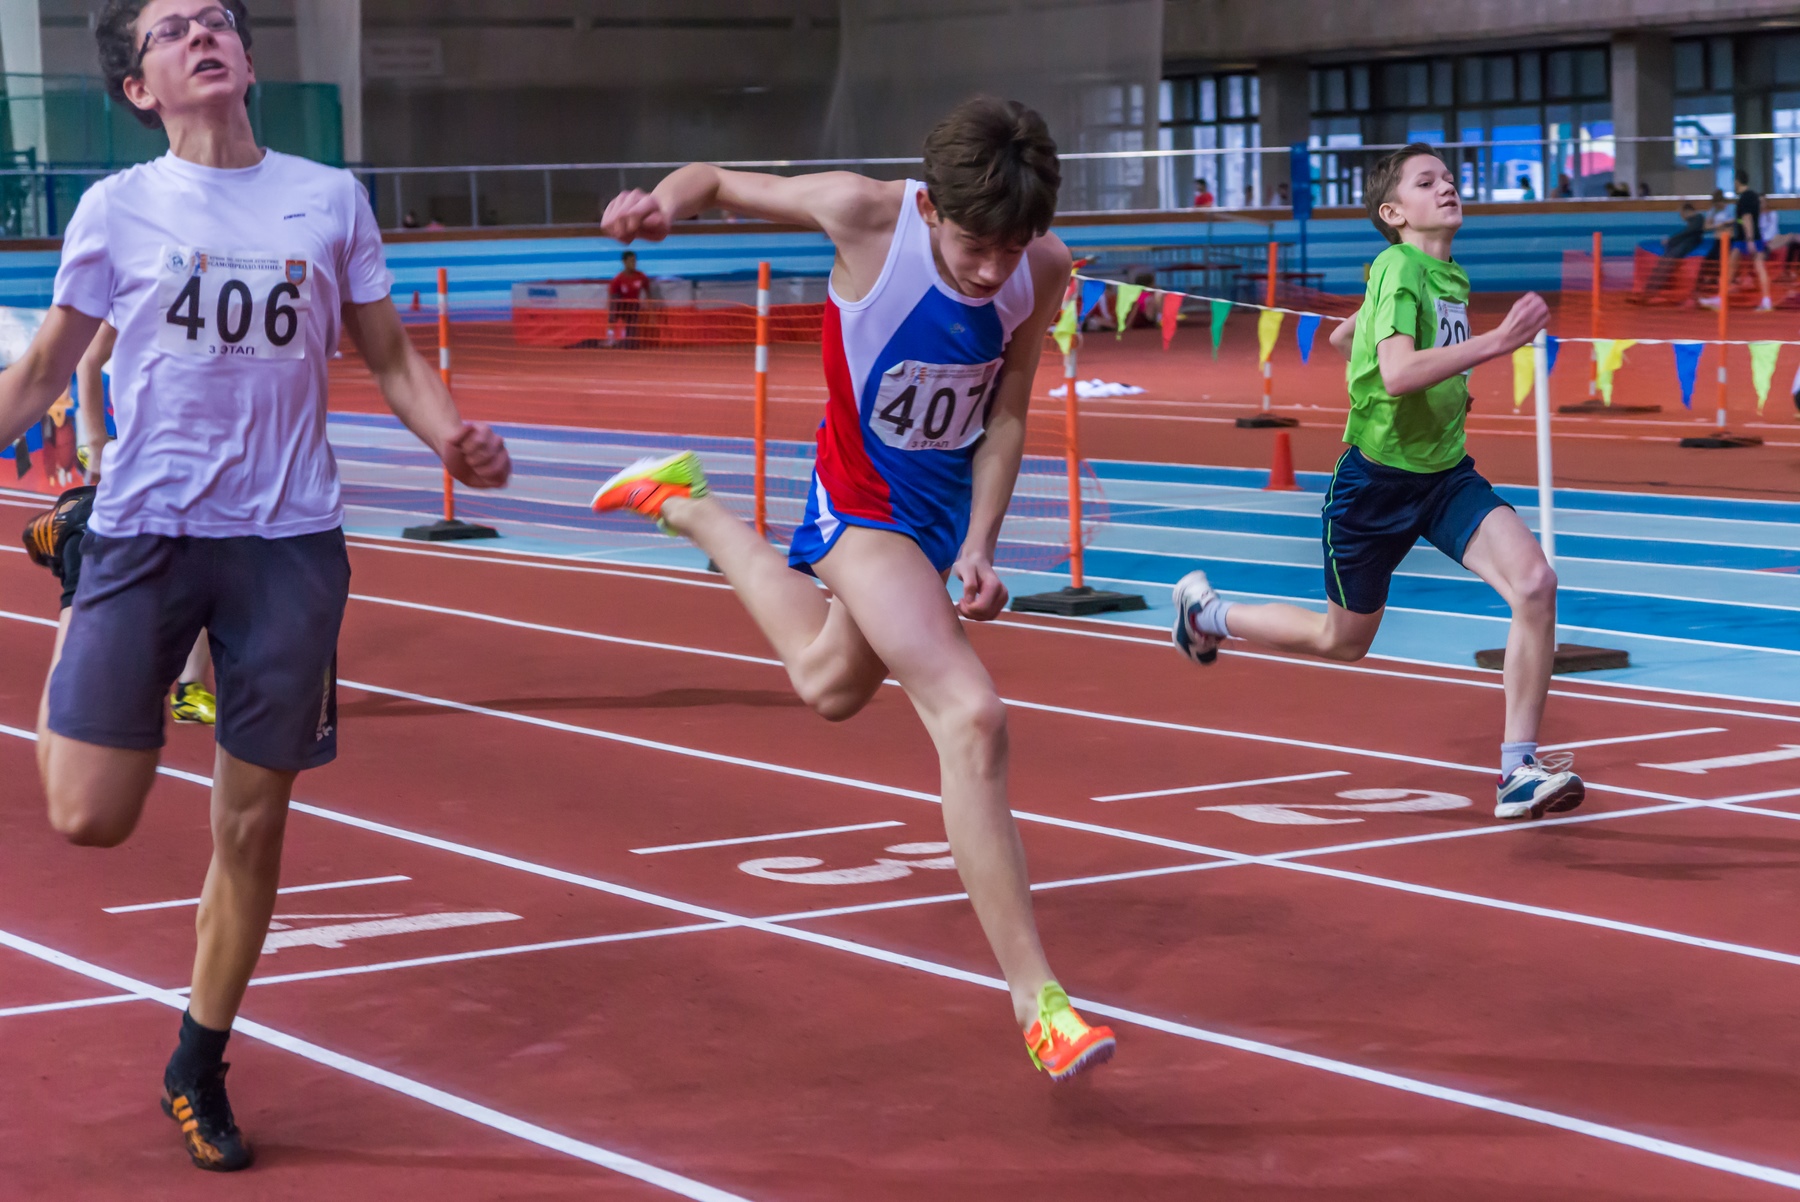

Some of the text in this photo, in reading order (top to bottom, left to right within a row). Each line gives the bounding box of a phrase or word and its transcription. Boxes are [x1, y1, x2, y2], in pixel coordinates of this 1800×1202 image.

[166, 275, 300, 347] 406
[220, 345, 255, 355] ЭТАП
[879, 382, 988, 440] 407
[920, 441, 949, 449] ЭТАП
[1195, 788, 1473, 825] 2
